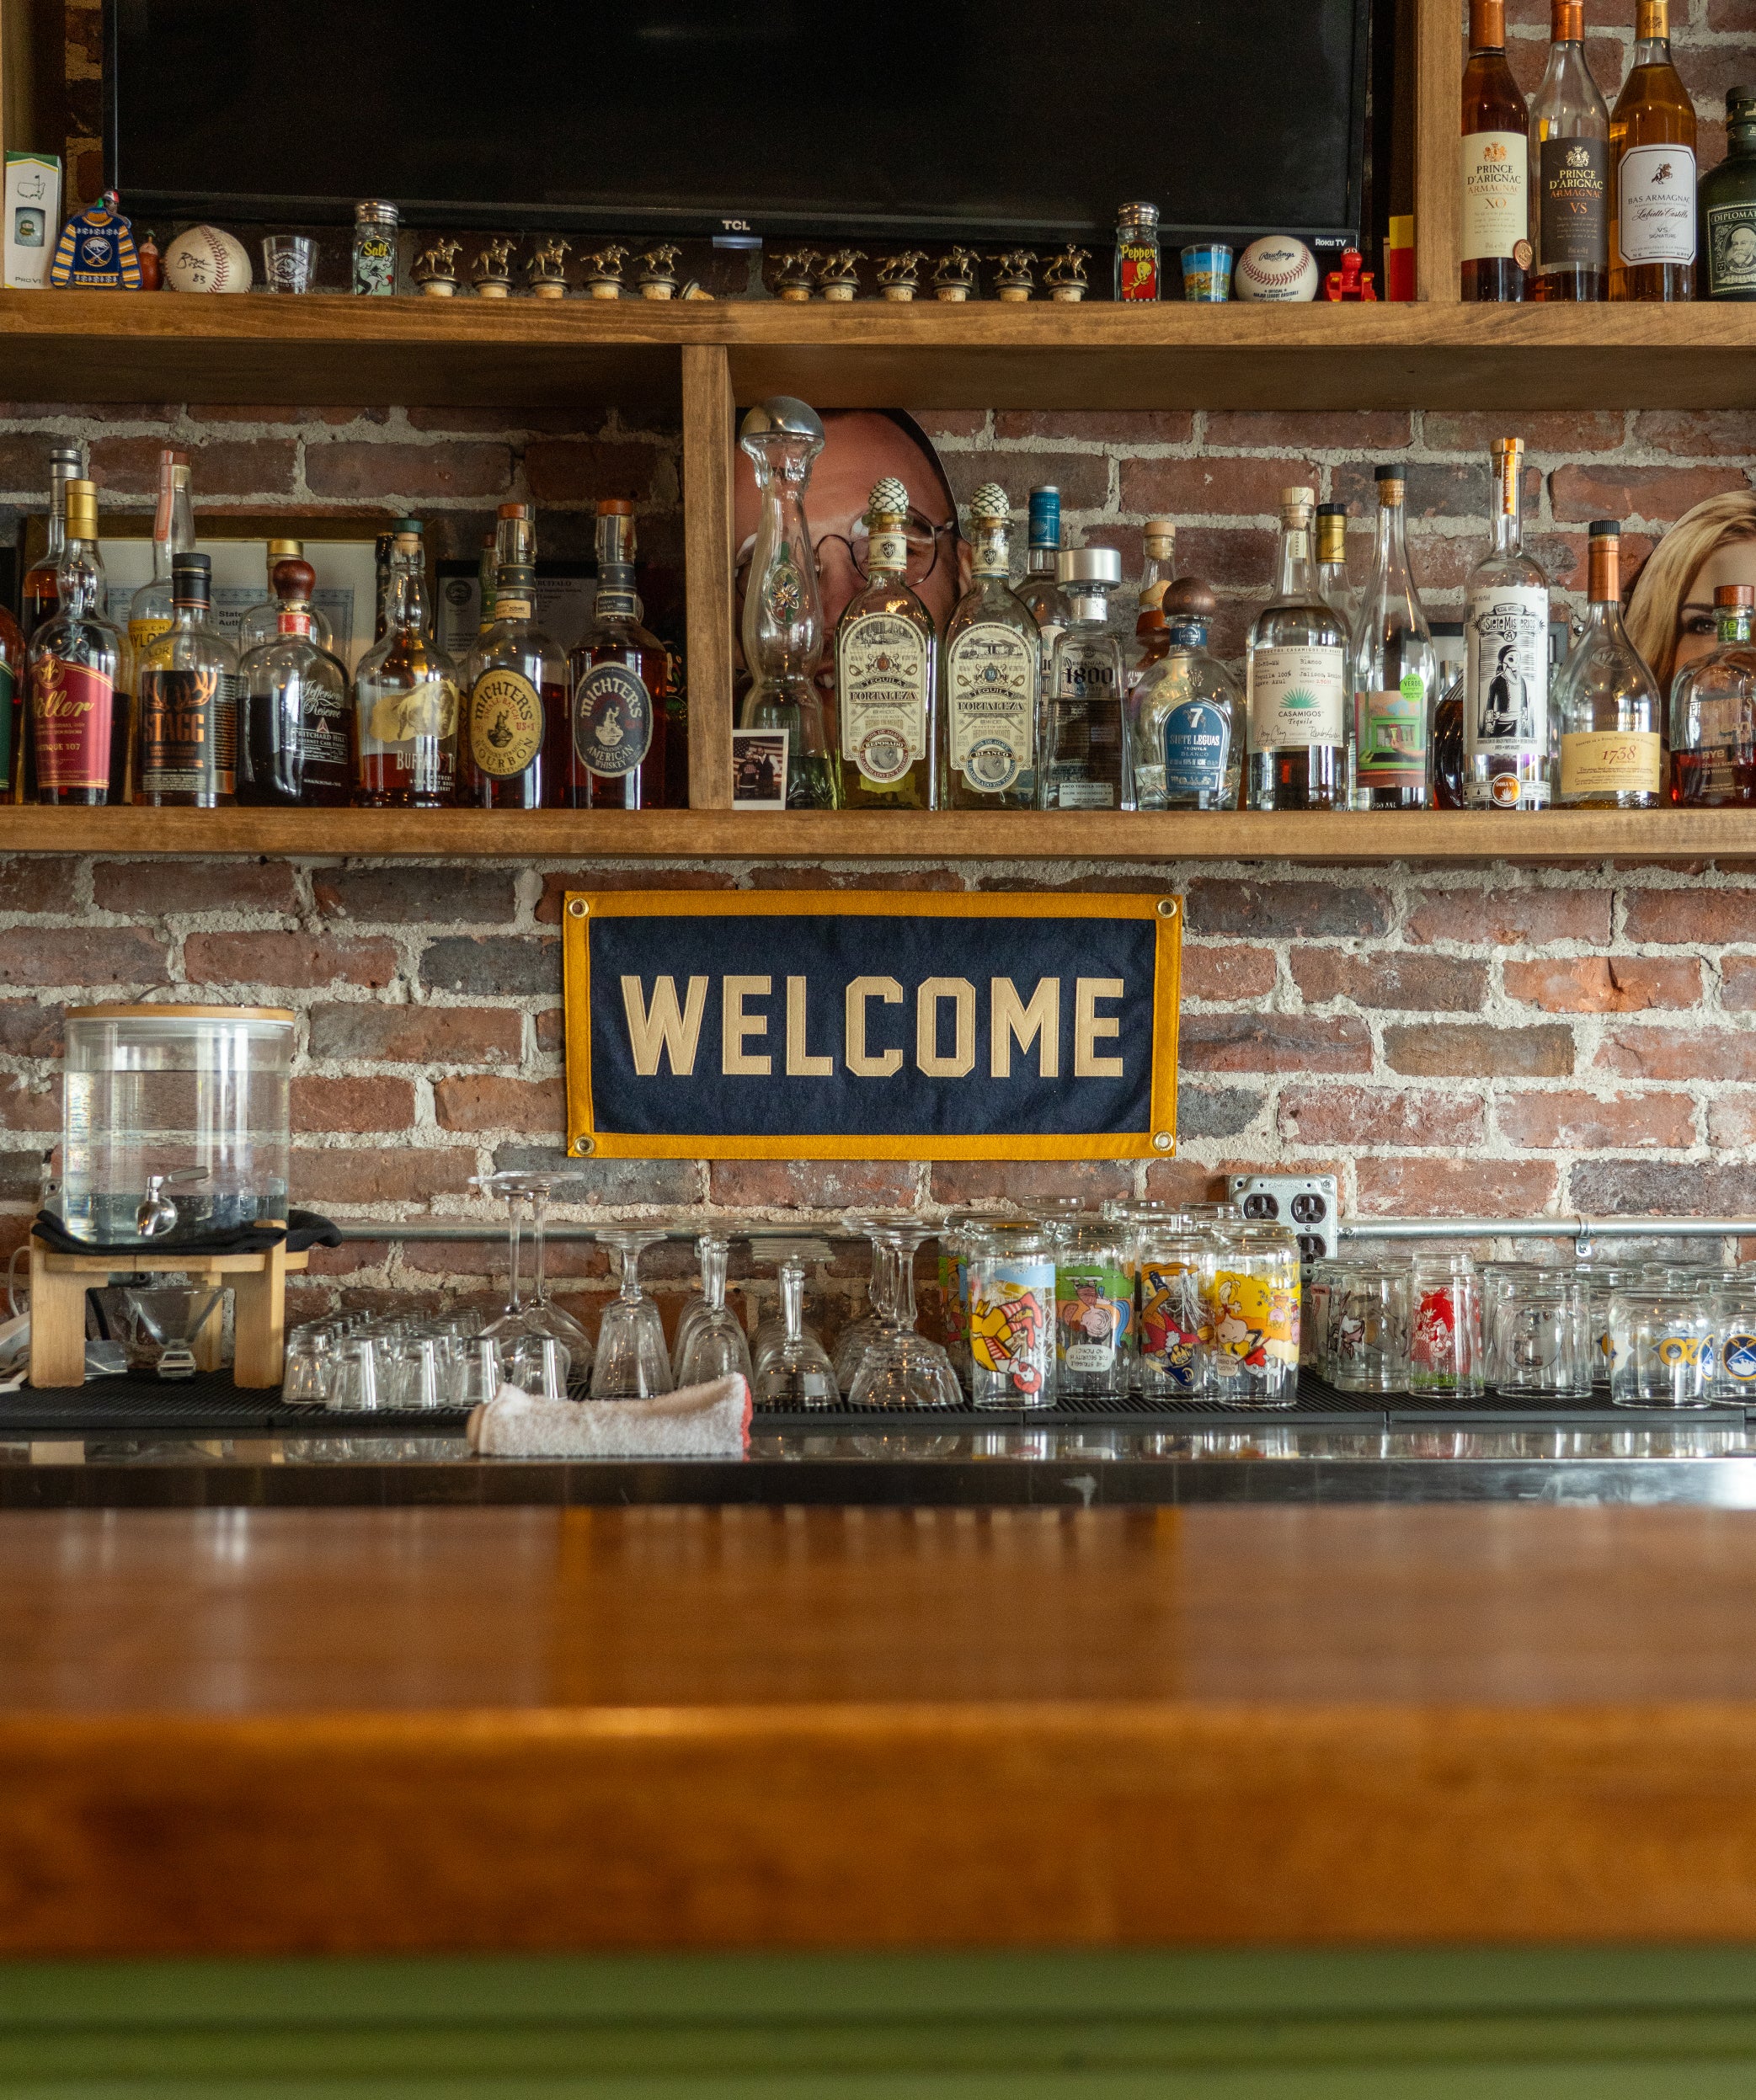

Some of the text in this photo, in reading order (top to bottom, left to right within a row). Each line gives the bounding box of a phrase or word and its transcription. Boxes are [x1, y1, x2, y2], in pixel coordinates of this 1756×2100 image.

[1476, 164, 1513, 174] PRINCE
[1559, 169, 1596, 179] PRINCE
[1467, 173, 1521, 185] D'ARIGNAC
[1549, 179, 1604, 190] D'ARIGNAC
[1468, 184, 1519, 195] ARMAGNAC
[1550, 189, 1603, 199] ARMAGNAC
[1628, 195, 1643, 205] BAS
[1645, 194, 1690, 203] ARMAGNAC
[1570, 202, 1588, 214] VS
[722, 220, 750, 231] TCL
[363, 242, 387, 257] Salt
[1120, 244, 1156, 261] Pepper
[1258, 249, 1296, 262] Rawlings
[1065, 667, 1113, 685] 1800
[1278, 670, 1292, 679] 100%
[866, 677, 903, 685] TEQUILA
[850, 690, 920, 701] FORTALEZA
[974, 687, 1009, 696] TEQUILA
[475, 681, 533, 721] MICHTER'S
[580, 677, 643, 718] MICHTER'S
[958, 701, 1026, 712] FORTALEZA
[1190, 708, 1204, 728] 7
[1288, 717, 1313, 727] Tequila
[515, 722, 535, 731] US-1
[1170, 734, 1220, 746] SIETE LEGUAS
[587, 744, 634, 762] AMERICAN
[1600, 744, 1636, 765] 1738
[397, 749, 440, 772] BUFFALO
[595, 760, 627, 770] WHISKEY
[621, 974, 1124, 1079] WELCOME
